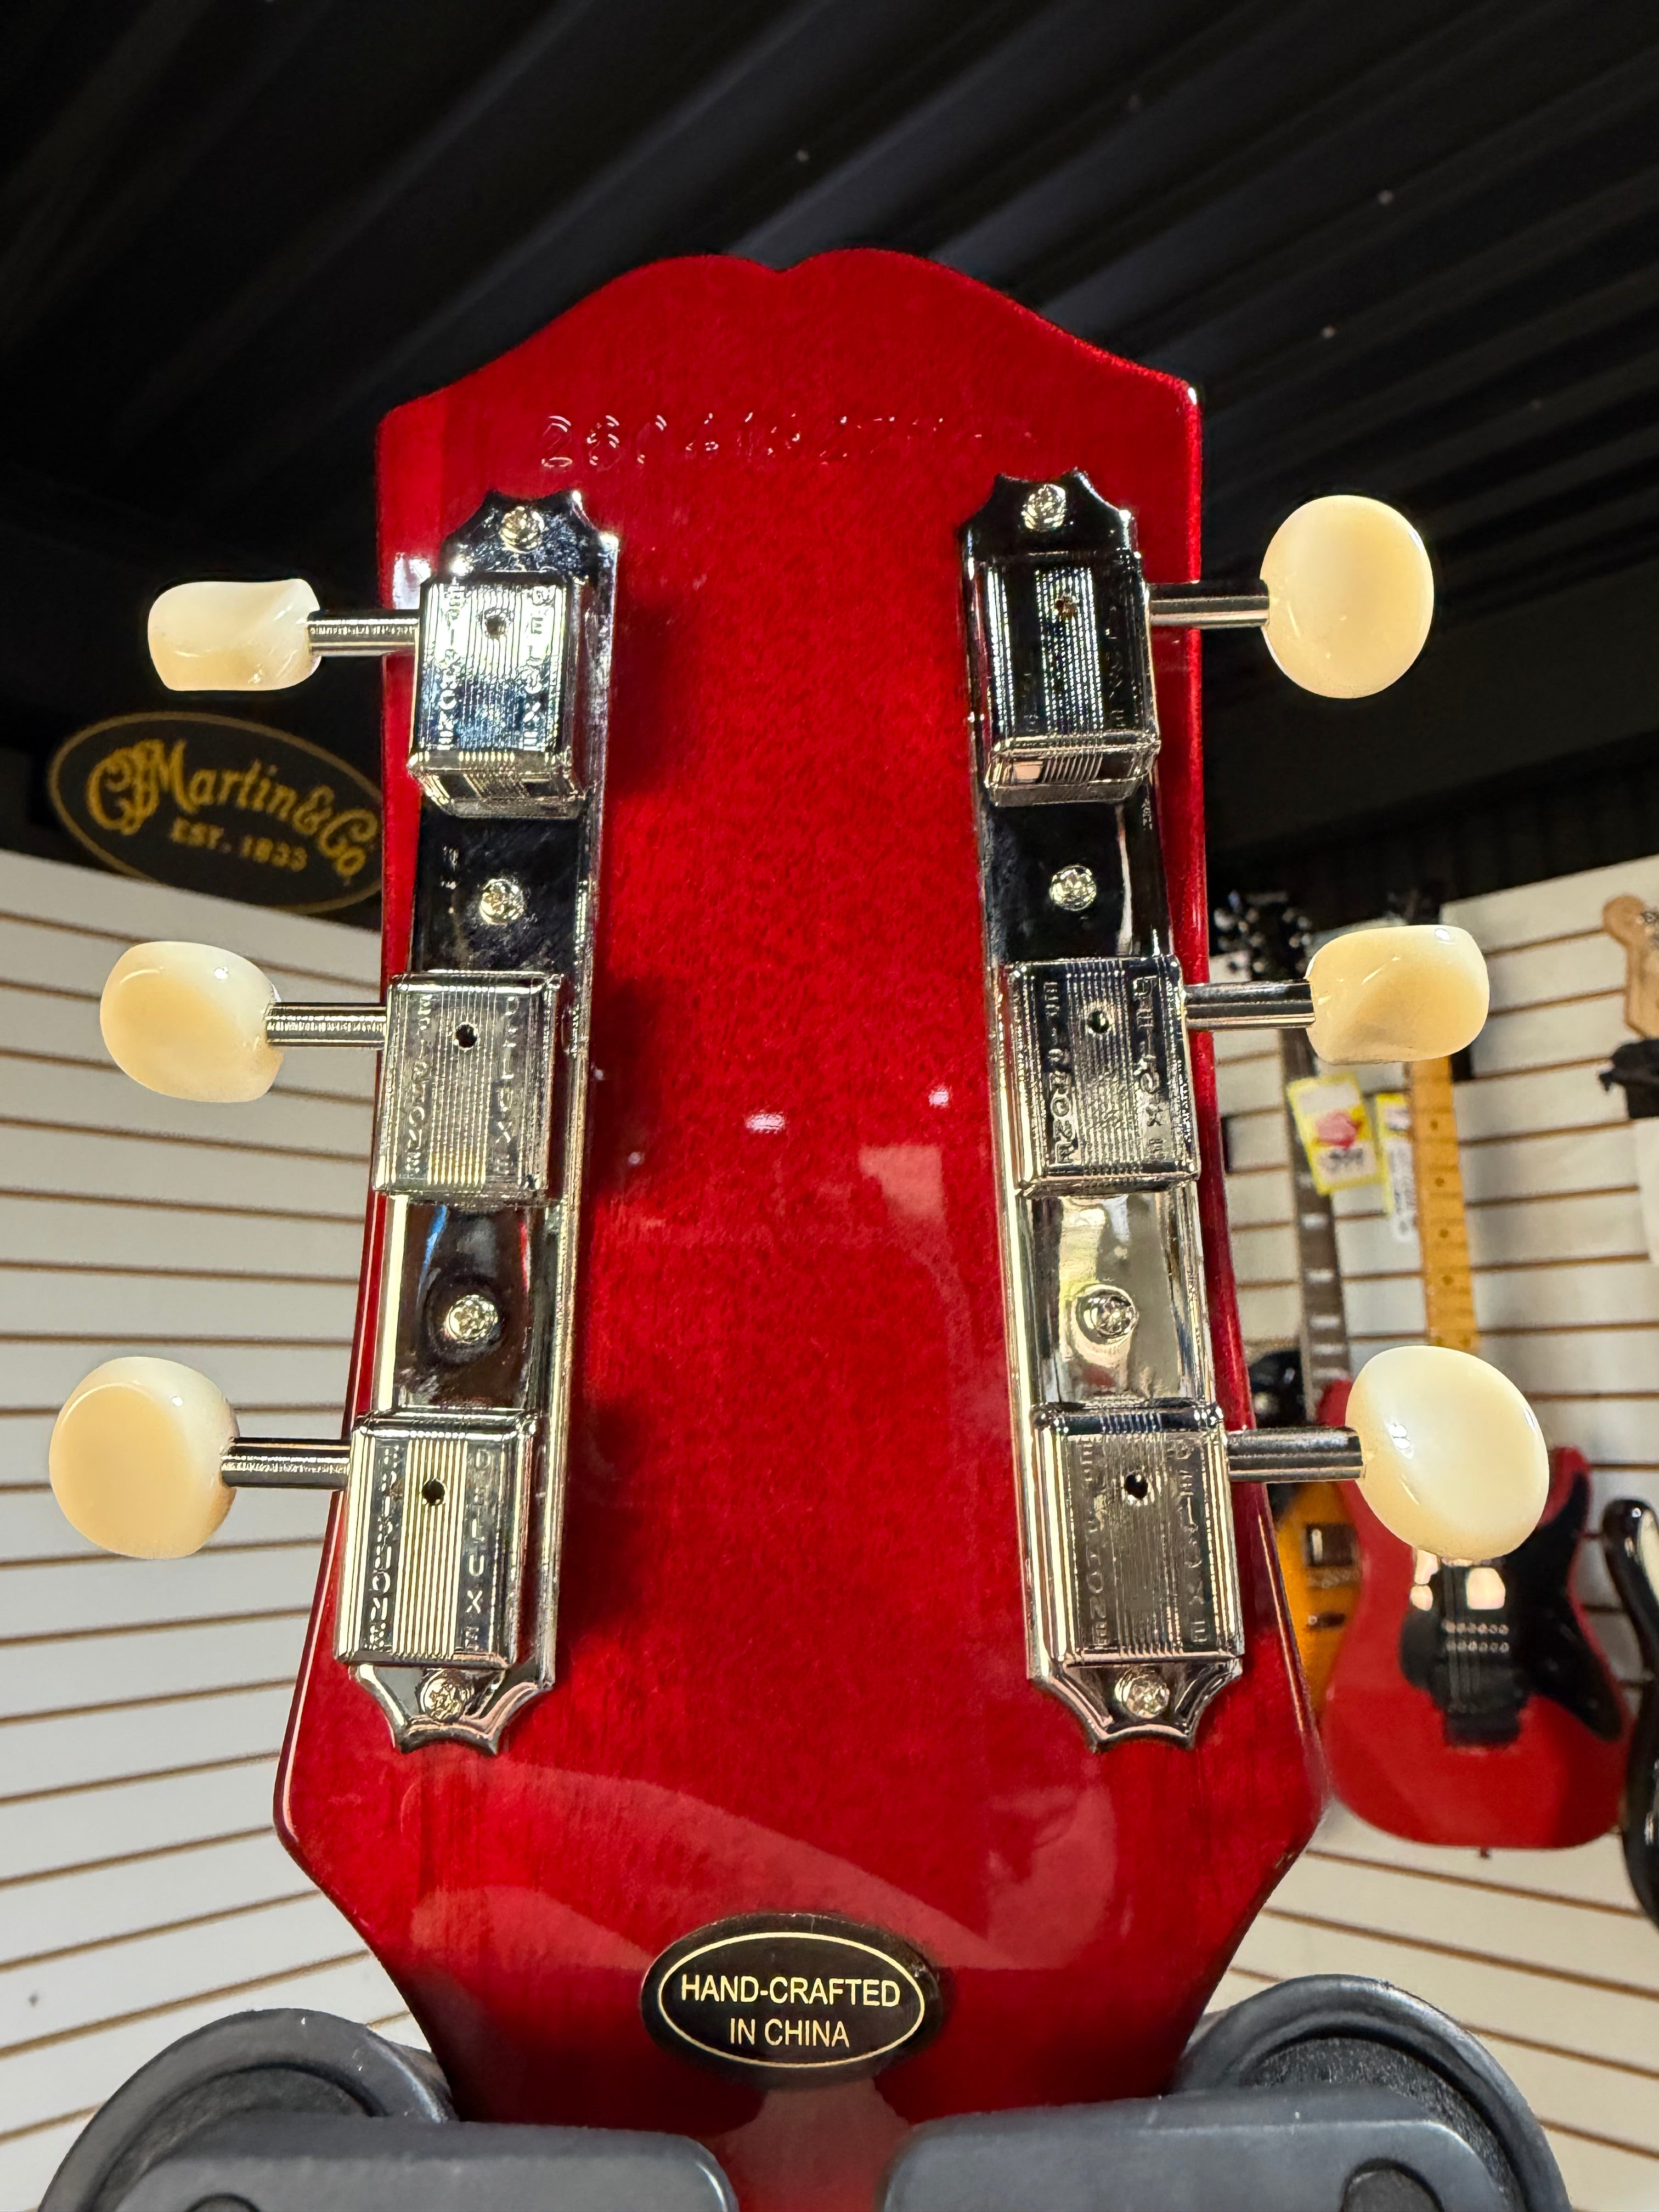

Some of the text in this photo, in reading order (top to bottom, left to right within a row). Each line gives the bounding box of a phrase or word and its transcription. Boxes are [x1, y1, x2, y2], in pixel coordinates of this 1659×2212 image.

[171, 817, 307, 872] EST. 1833
[681, 1974, 900, 2007] HAND-CRAFTED
[730, 2018, 849, 2048] IN CHINA
